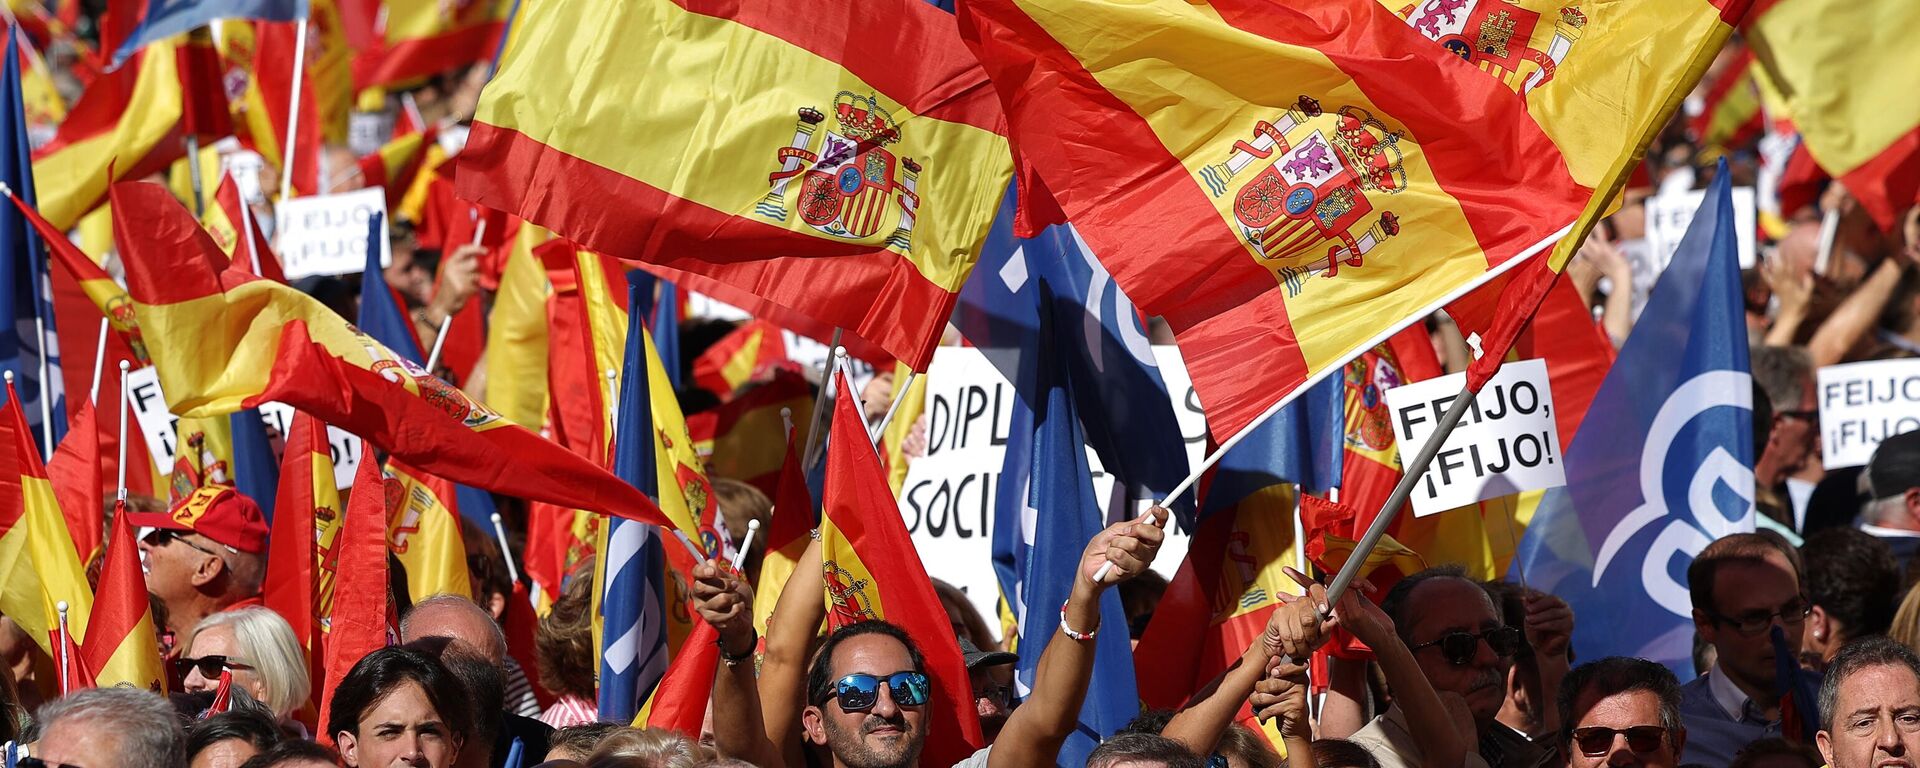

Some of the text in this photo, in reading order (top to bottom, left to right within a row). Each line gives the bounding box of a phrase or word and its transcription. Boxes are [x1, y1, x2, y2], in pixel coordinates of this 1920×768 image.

[927, 383, 1009, 456] DIPL
[1398, 380, 1549, 441] FEIJO,
[1423, 430, 1554, 499] ¡FIJO!
[907, 471, 990, 540] SOCI
